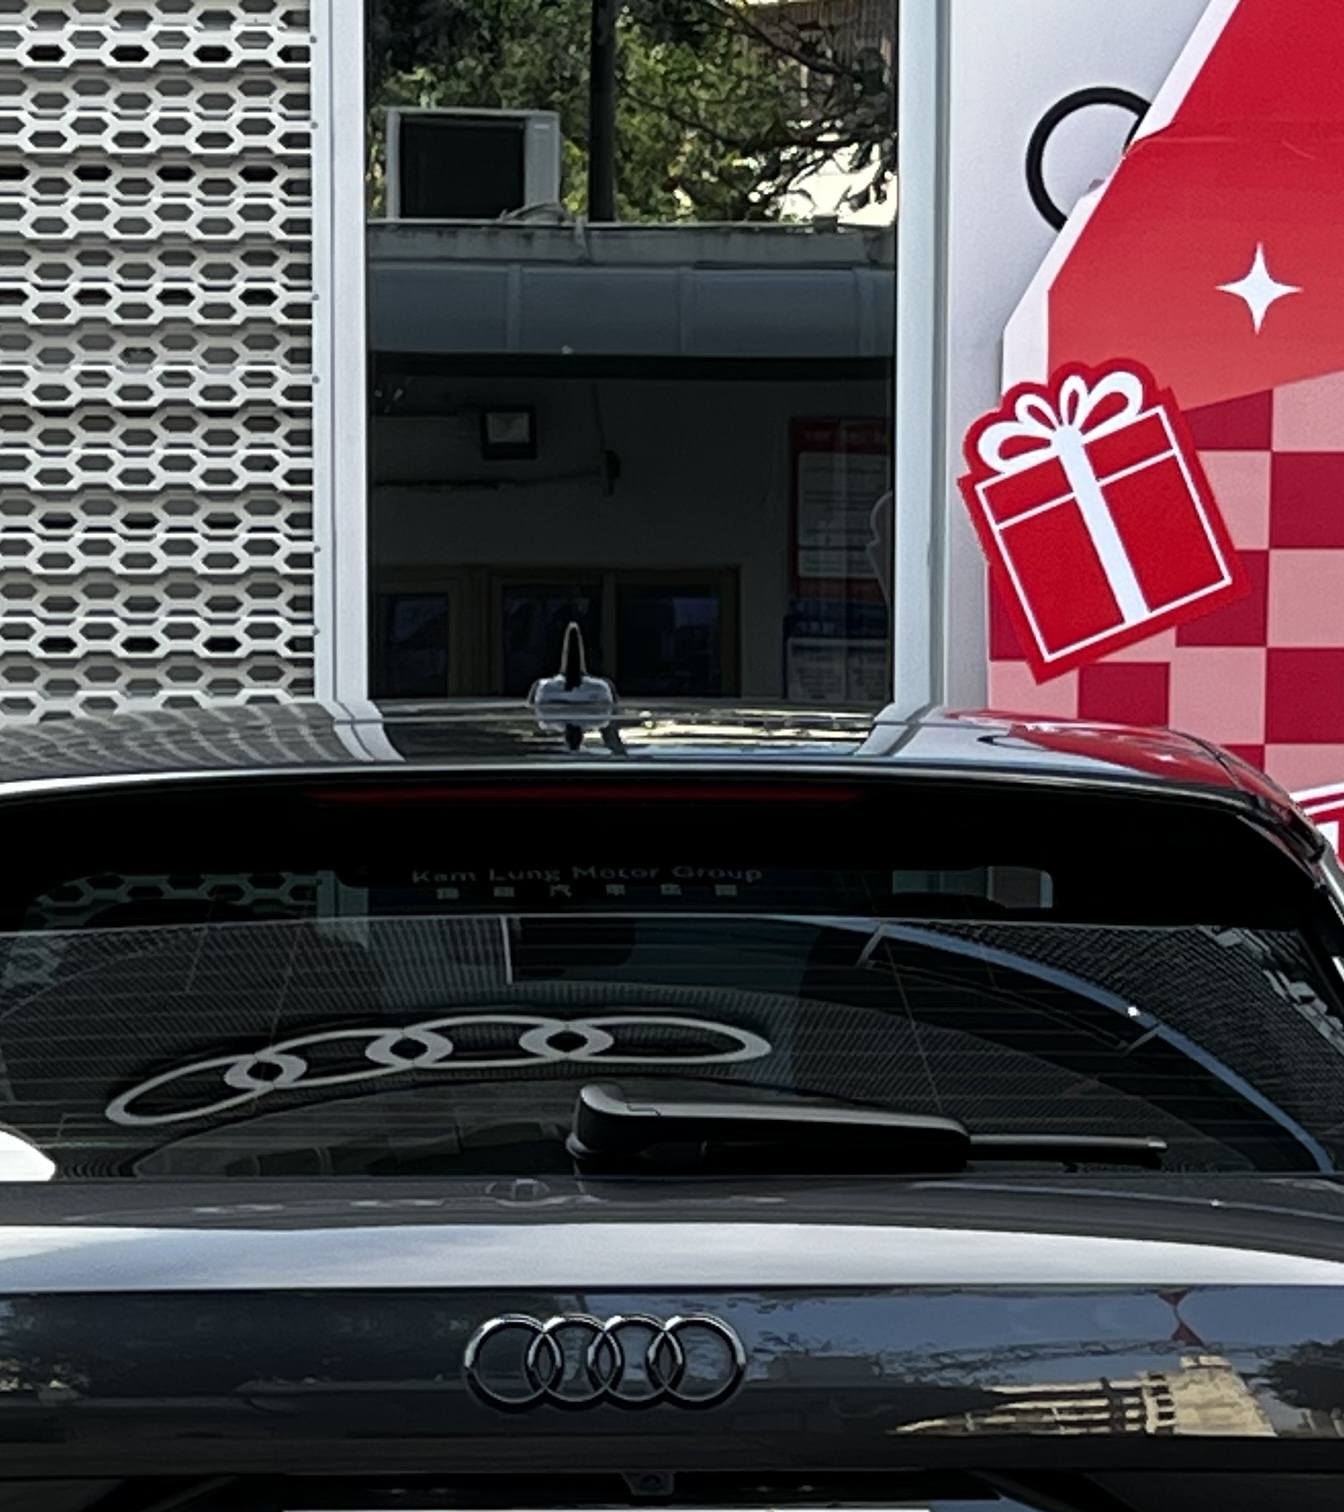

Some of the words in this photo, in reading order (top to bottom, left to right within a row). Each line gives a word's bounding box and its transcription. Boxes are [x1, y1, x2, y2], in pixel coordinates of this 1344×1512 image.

[411, 869, 477, 884] Kam
[488, 868, 561, 883] Lung
[571, 865, 660, 881] Motor
[671, 864, 763, 884] Group
